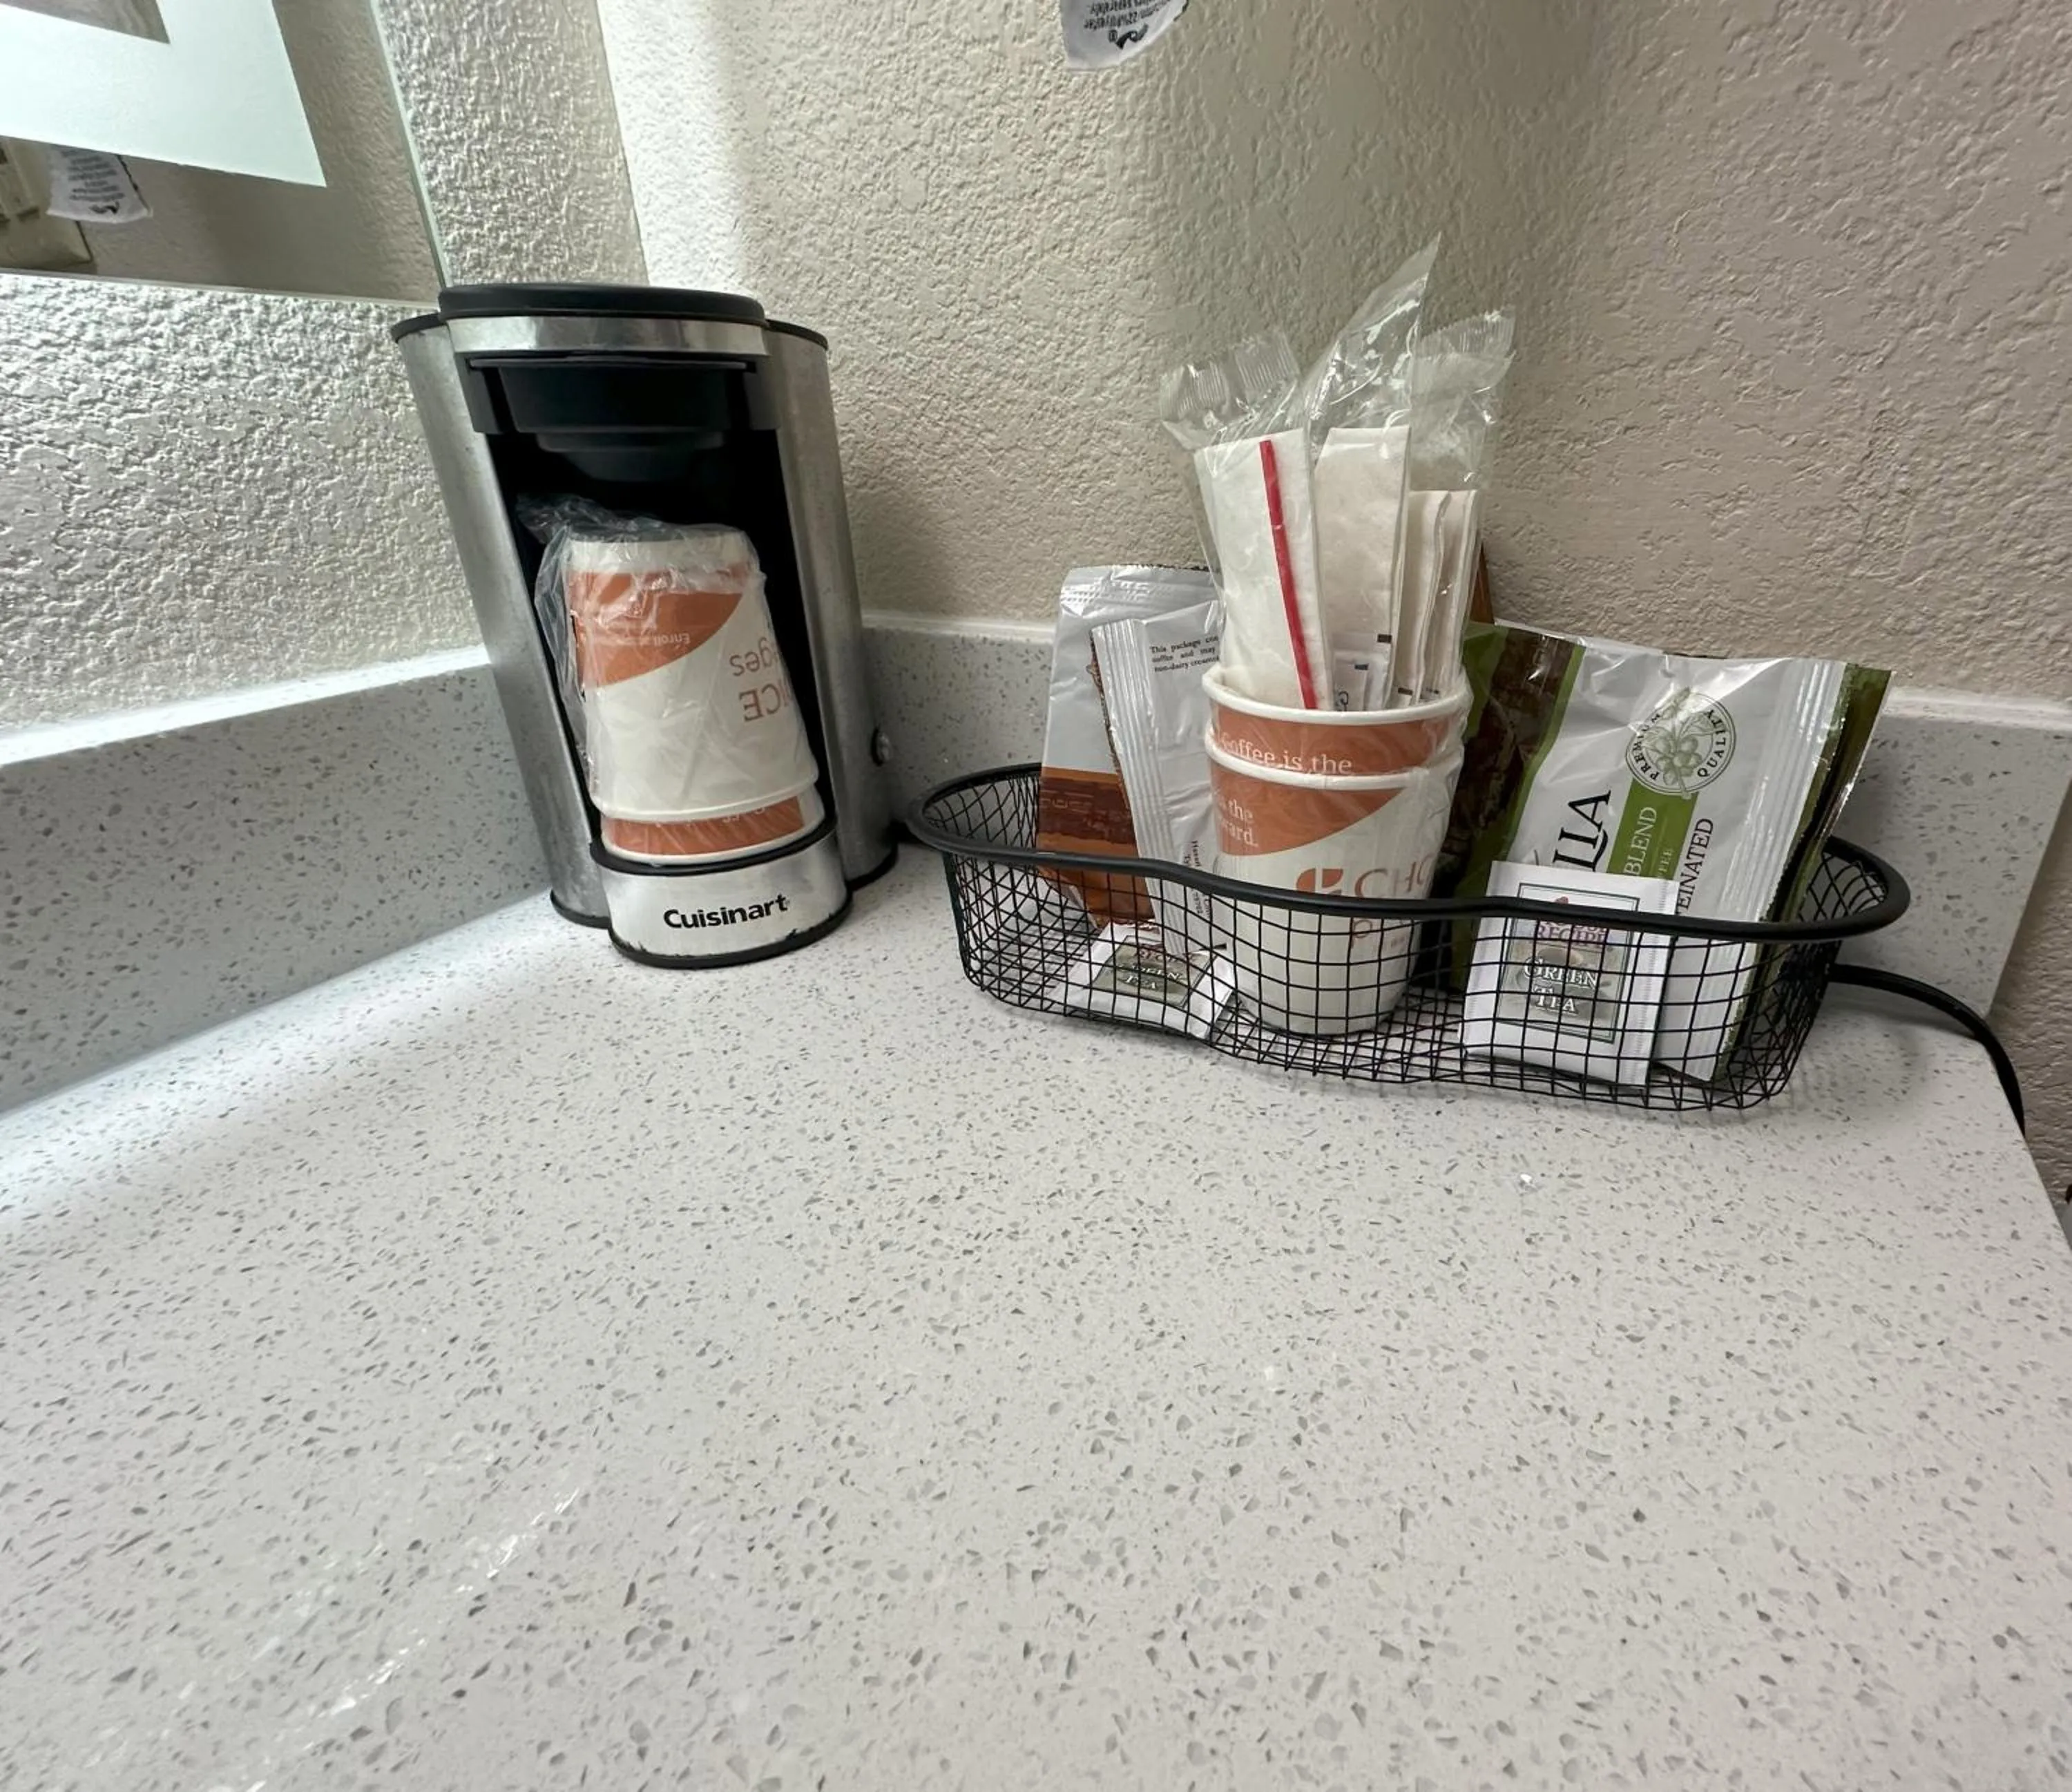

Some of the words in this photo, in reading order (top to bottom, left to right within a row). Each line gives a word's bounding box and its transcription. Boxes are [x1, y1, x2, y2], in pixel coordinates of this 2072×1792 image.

[653, 632, 690, 645] Enroll
[1171, 640, 1201, 653] package
[729, 636, 776, 677] ges
[1632, 713, 1661, 781] PREMIUM
[1697, 709, 1727, 779] QUALITY
[1283, 750, 1303, 770] is
[1312, 754, 1354, 775] the
[1228, 799, 1254, 824] the
[1624, 806, 1658, 876] BLEND
[663, 893, 789, 928] Cuisinart
[1524, 957, 1600, 989] GREEN
[1533, 984, 1579, 1013] TEA
